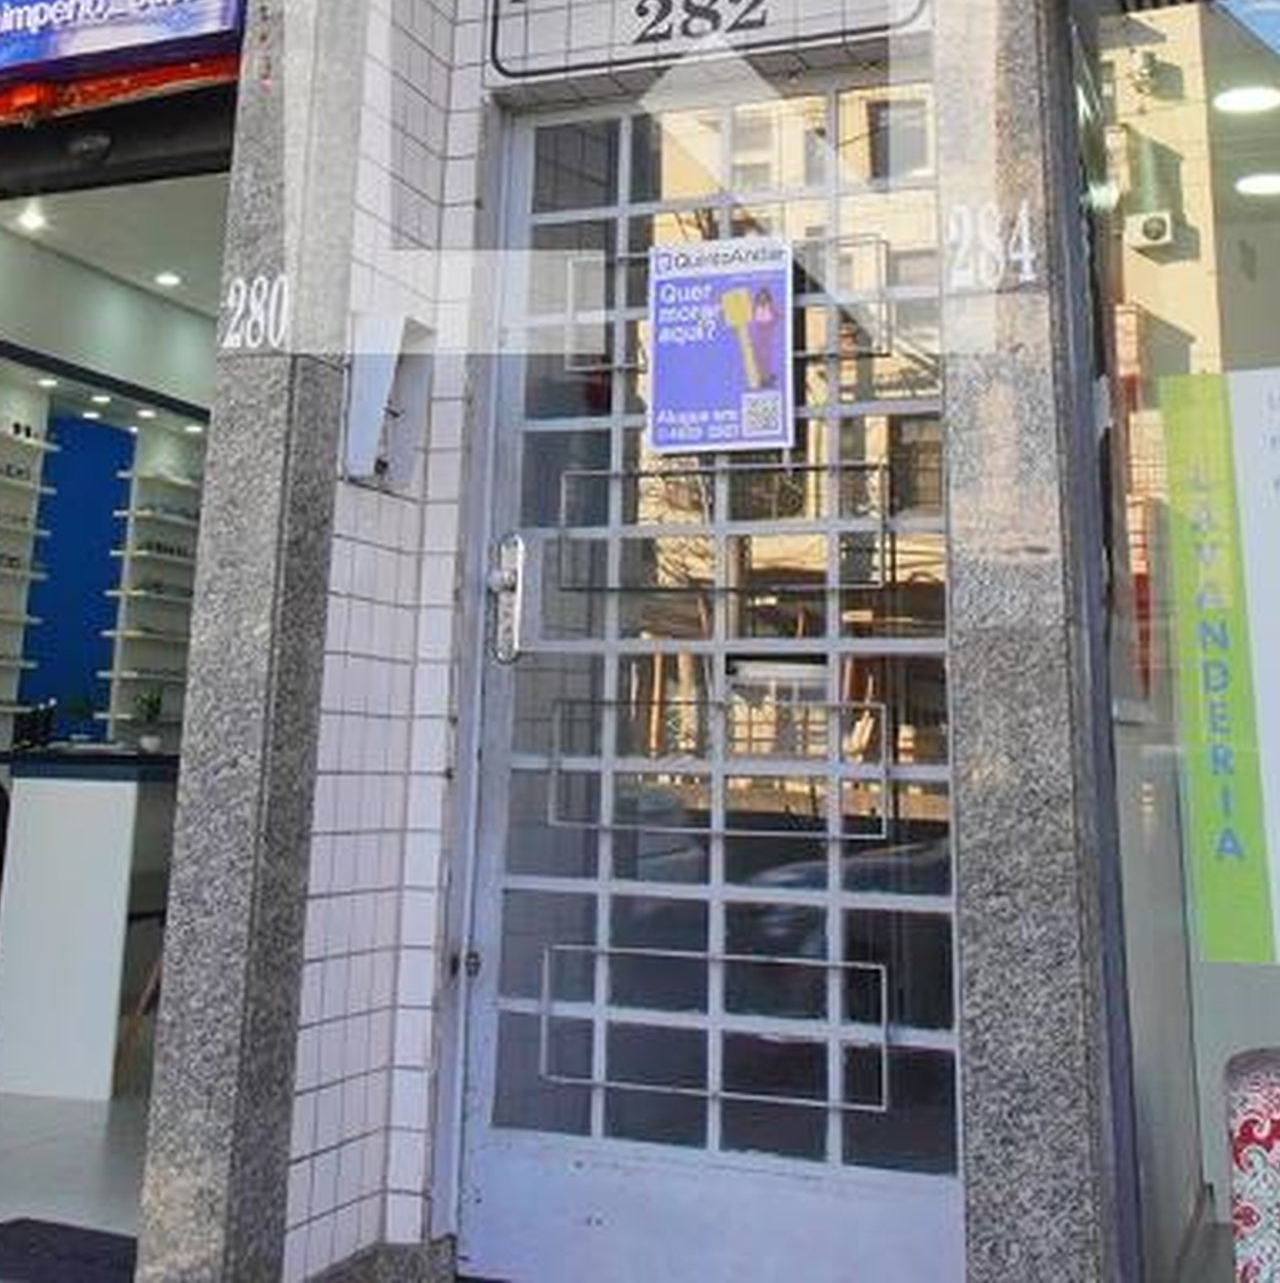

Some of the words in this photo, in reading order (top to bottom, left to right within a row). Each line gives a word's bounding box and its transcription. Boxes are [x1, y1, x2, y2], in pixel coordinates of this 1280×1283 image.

[941, 199, 1038, 292] 284
[221, 274, 288, 348] 280
[660, 284, 712, 303] Quer
